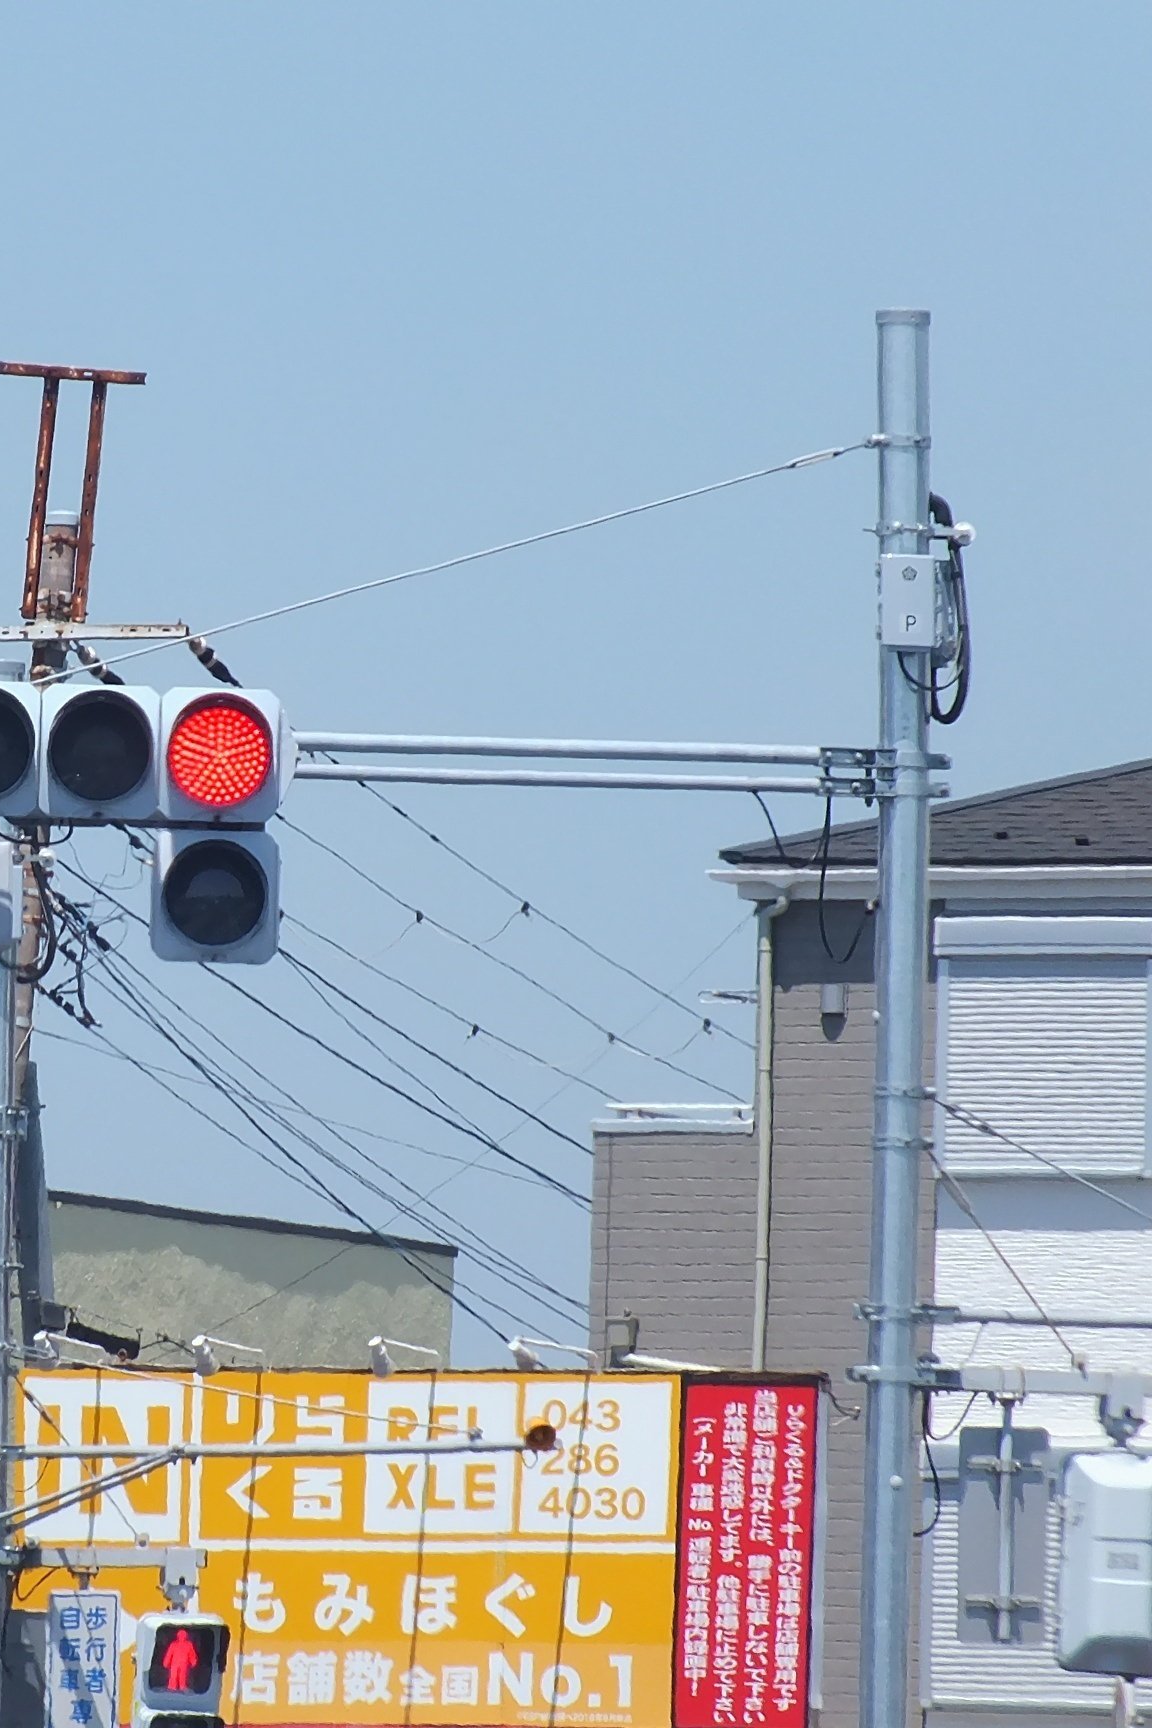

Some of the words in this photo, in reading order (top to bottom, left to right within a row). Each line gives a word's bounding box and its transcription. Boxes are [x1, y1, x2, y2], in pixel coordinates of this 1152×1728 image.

[225, 1394, 345, 1444] りら
[541, 1399, 622, 1433] 043
[540, 1443, 620, 1477] 286
[225, 1465, 343, 1520] くる
[386, 1463, 497, 1511] XLE
[538, 1486, 646, 1522] 4030
[233, 1572, 614, 1639] もみほぐし
[59, 1606, 81, 1692] 自転車
[85, 1606, 106, 1693] 歩行者
